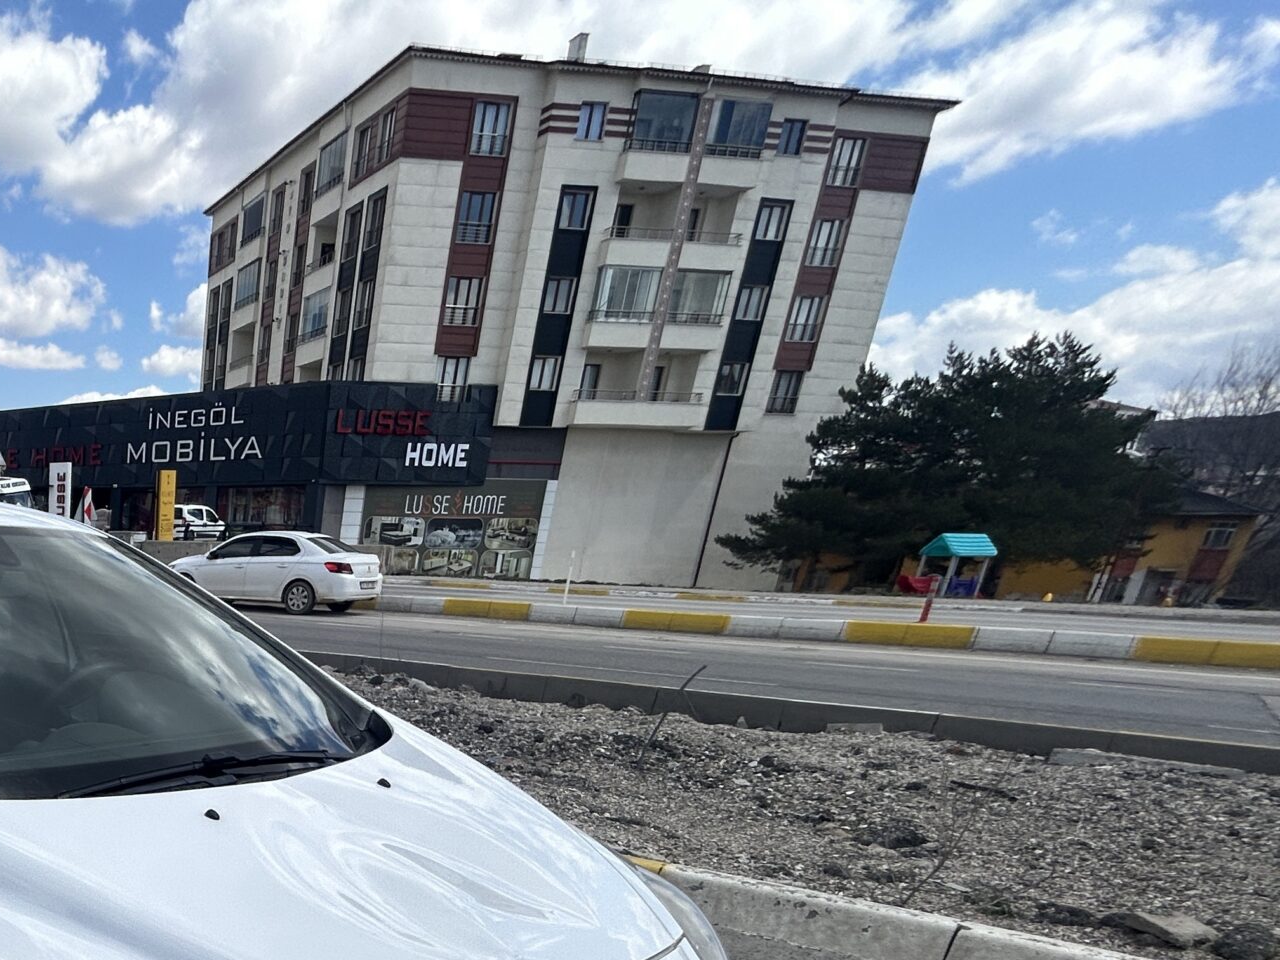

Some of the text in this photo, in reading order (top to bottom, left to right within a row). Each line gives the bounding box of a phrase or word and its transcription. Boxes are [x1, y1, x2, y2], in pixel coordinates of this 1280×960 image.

[148, 402, 244, 430] İNEGÖL
[336, 408, 433, 436] LUSSE
[30, 444, 102, 467] HOME
[126, 431, 262, 464] MOBİLYA
[404, 442, 470, 468] HOME
[55, 472, 66, 517] USSE
[404, 495, 507, 515] LUSSE HOME
